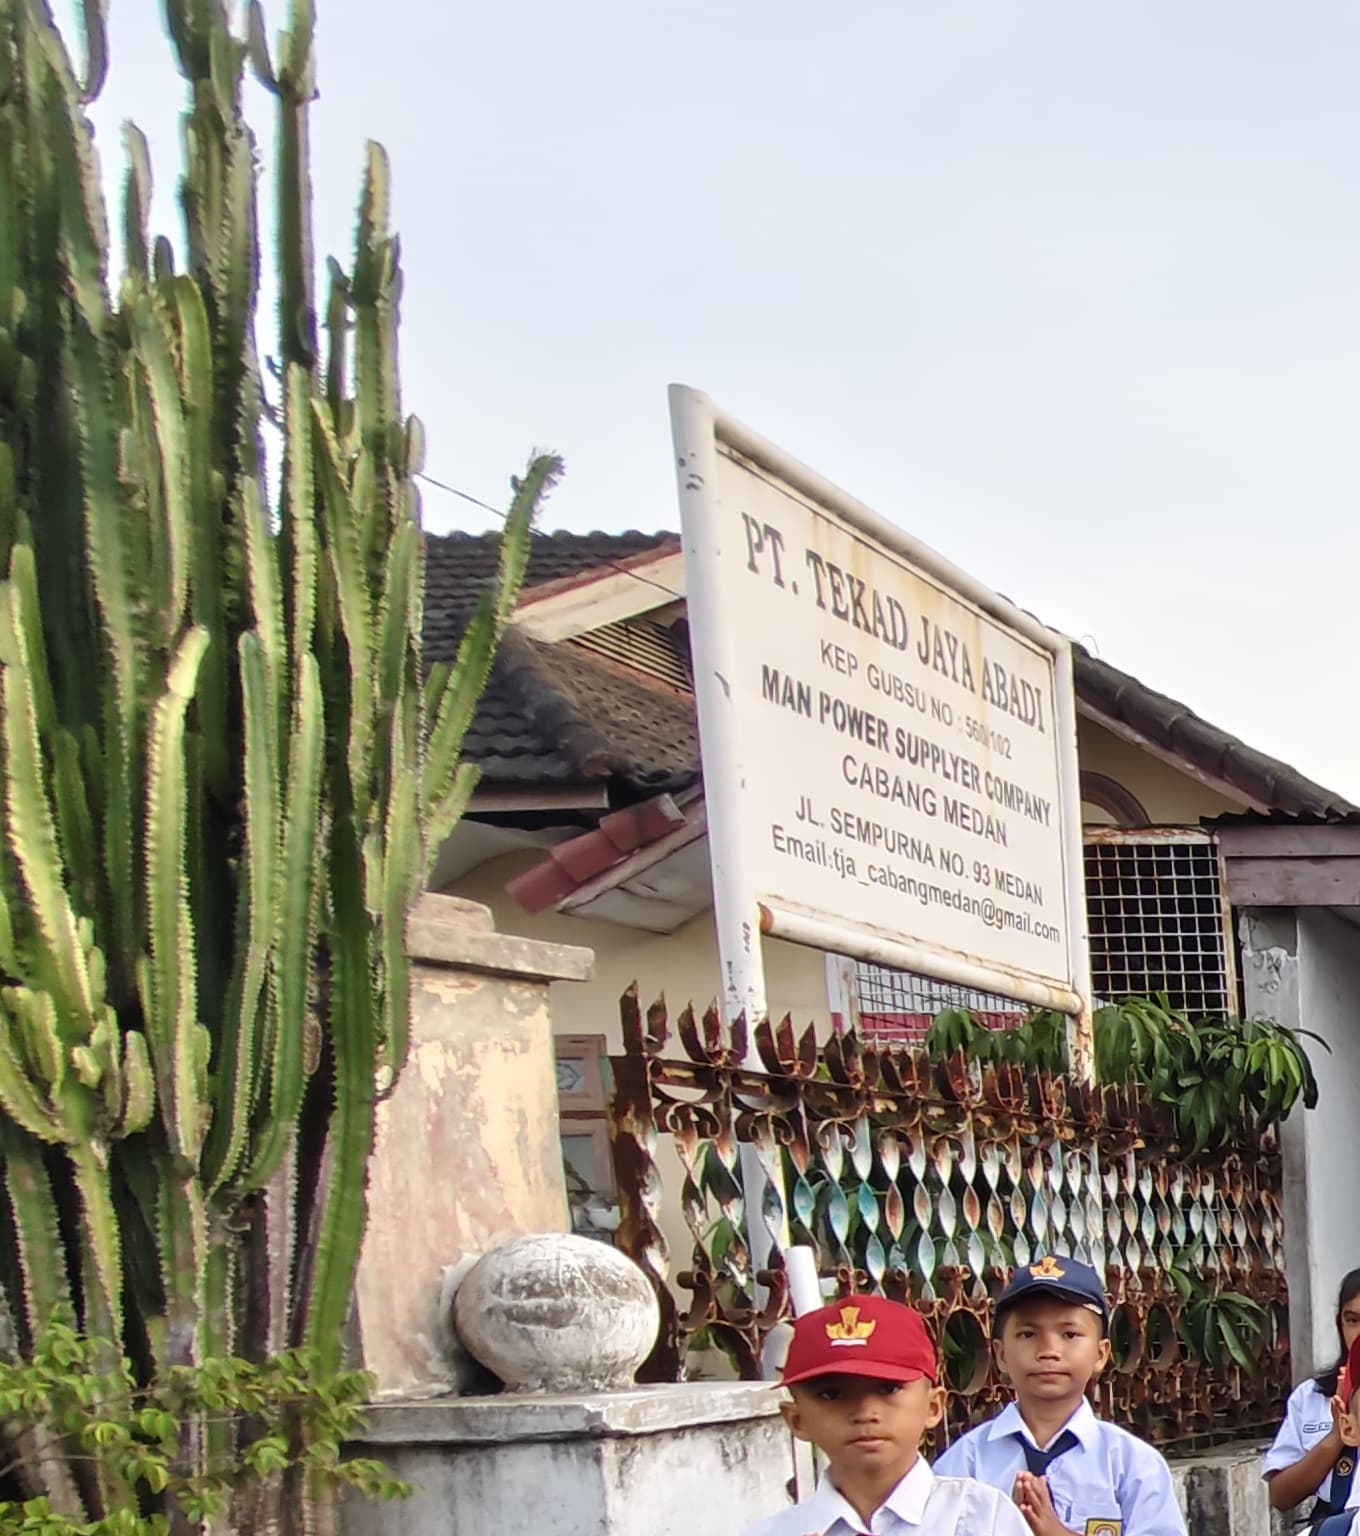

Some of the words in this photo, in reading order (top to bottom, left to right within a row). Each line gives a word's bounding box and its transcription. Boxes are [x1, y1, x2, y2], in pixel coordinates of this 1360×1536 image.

[742, 512, 798, 595] PT.
[806, 549, 907, 651] TEKAD
[917, 616, 975, 694] JAYA
[982, 657, 1045, 734] ABADI
[821, 637, 858, 677] KEP
[867, 664, 926, 713] GUBSU
[931, 696, 953, 726] NO
[762, 664, 812, 718] MAN
[819, 690, 890, 754] POWER
[895, 727, 982, 794] SUPPLYER
[985, 771, 1050, 827] COMPANY
[842, 754, 937, 817] CABANG
[943, 795, 1008, 847] MEDAN
[796, 795, 824, 828] JL.
[830, 807, 935, 868] SEMPURNA
[939, 848, 969, 879] NO.
[973, 860, 990, 887] 93
[994, 868, 1043, 906] MEDAN
